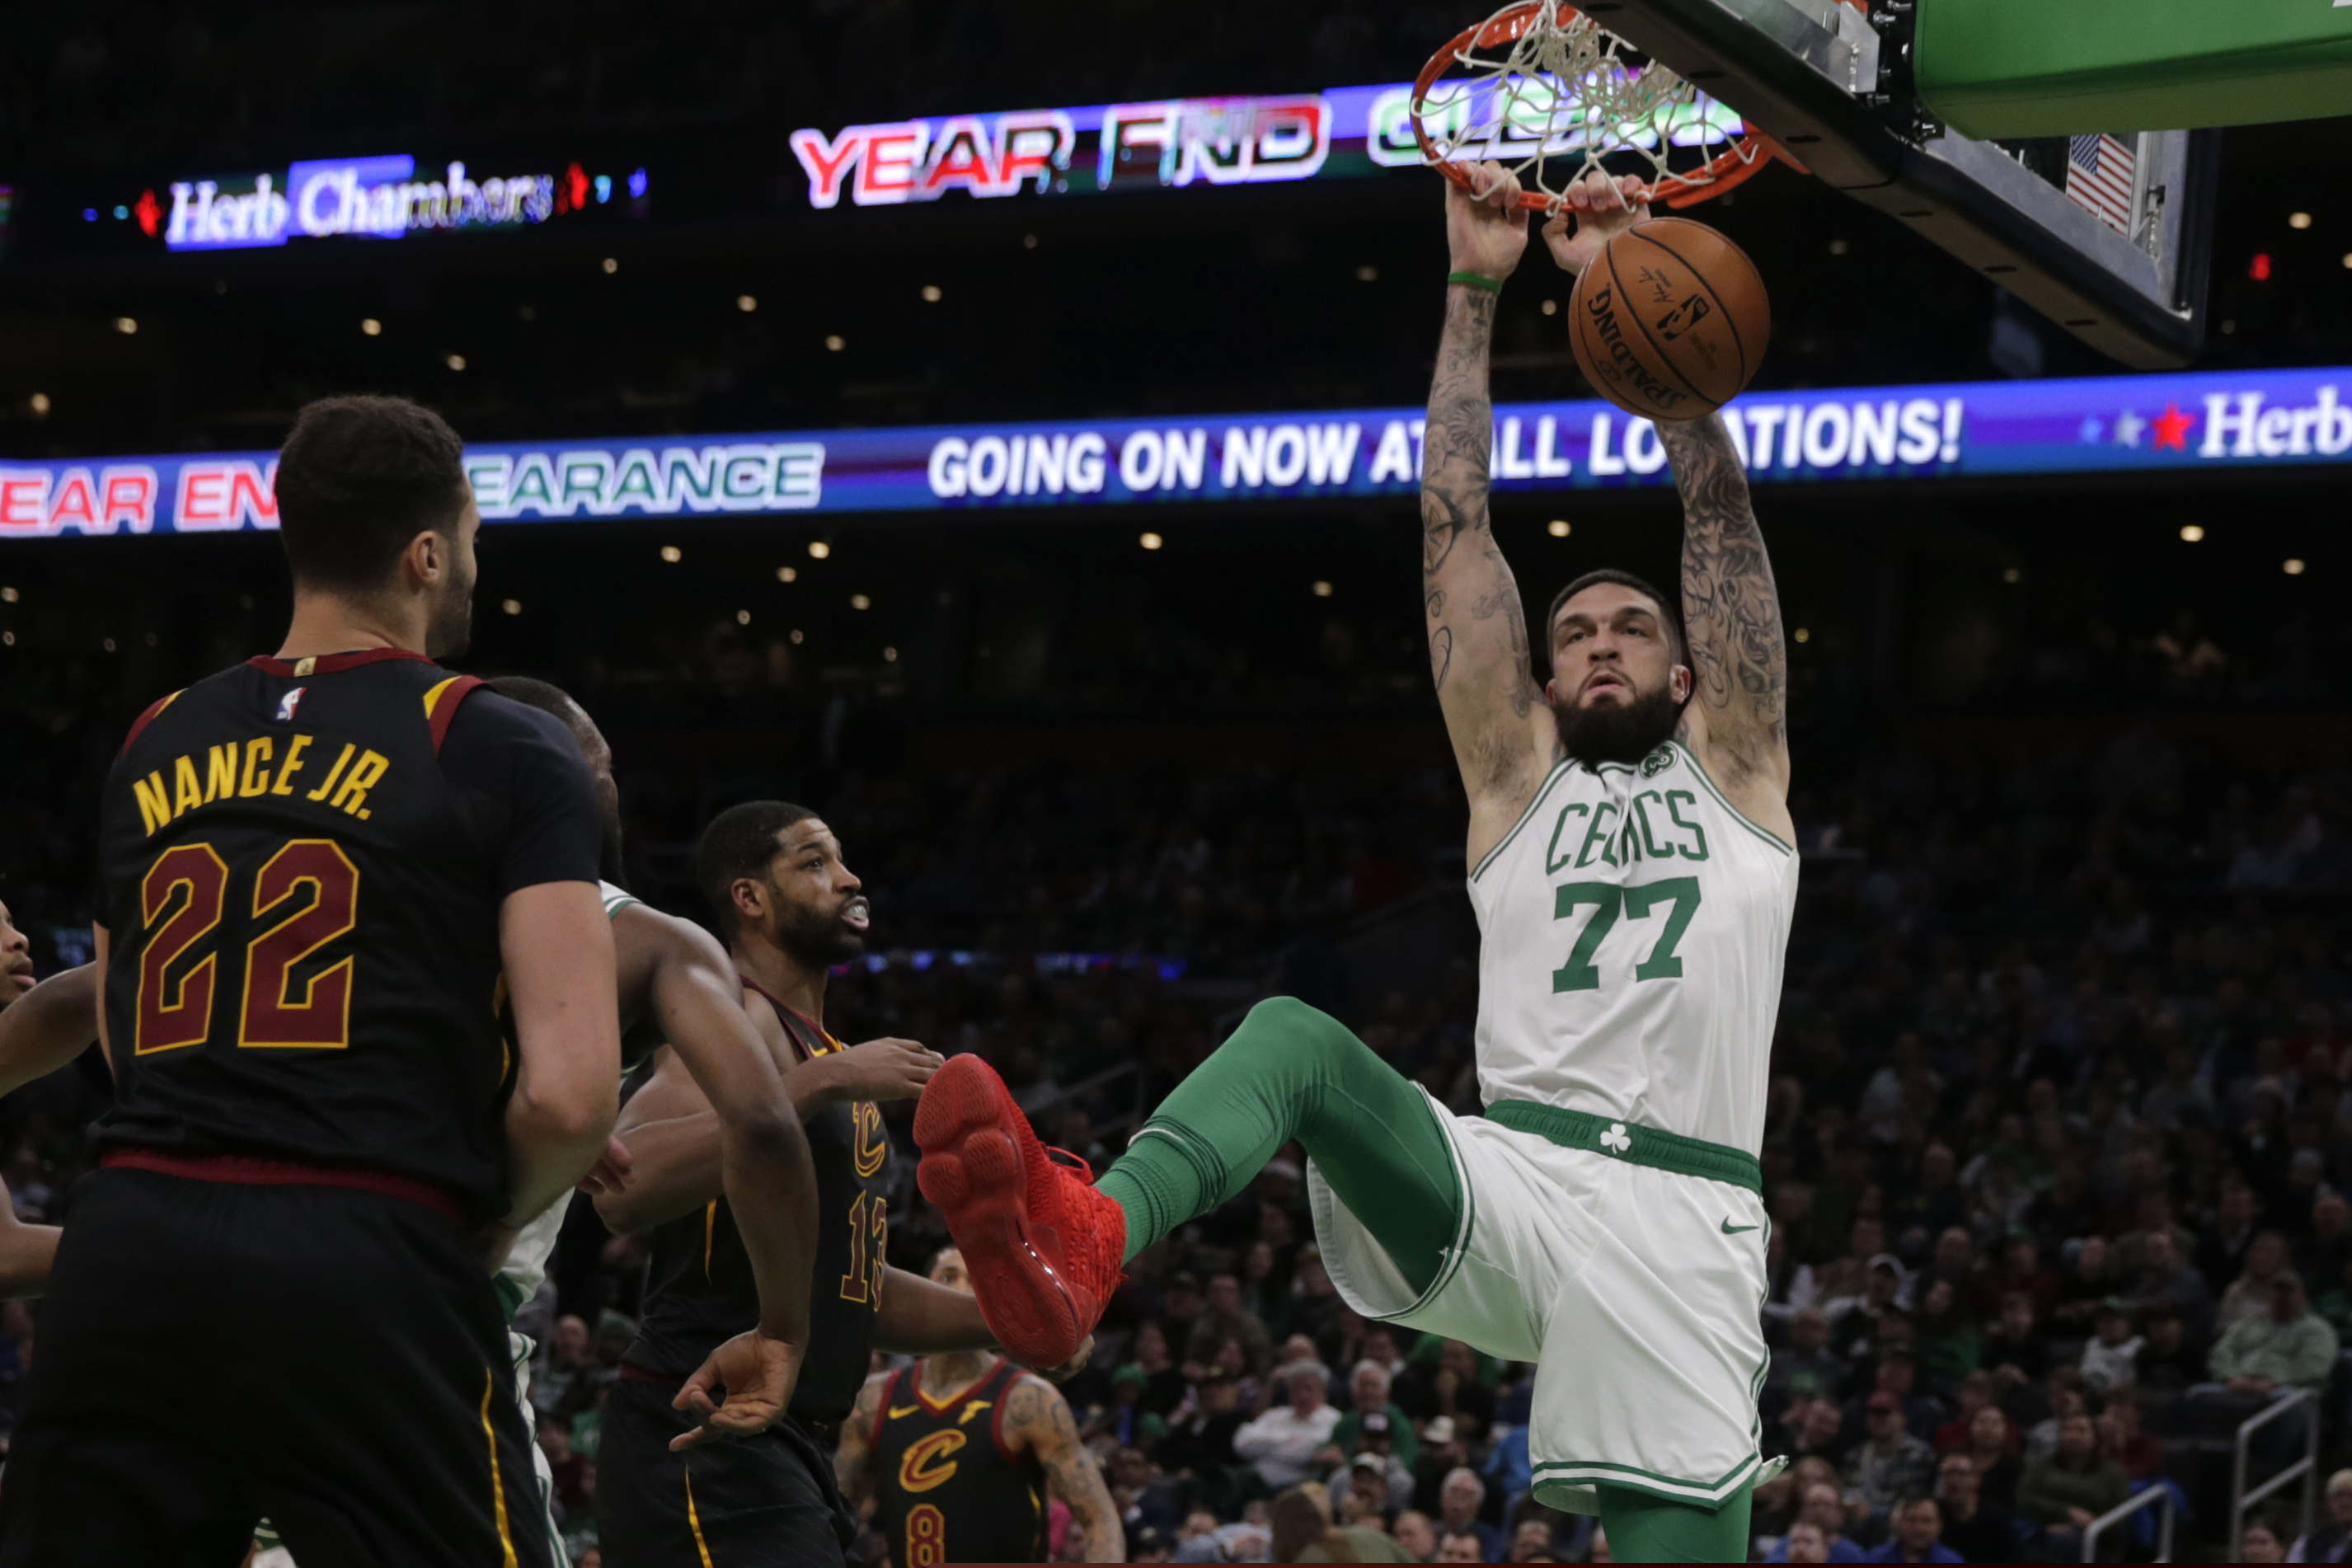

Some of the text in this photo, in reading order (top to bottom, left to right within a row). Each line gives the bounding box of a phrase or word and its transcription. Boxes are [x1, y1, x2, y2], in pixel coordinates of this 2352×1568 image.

[166, 161, 555, 245] Herb Chambers
[790, 110, 1076, 209] YEAR
[1588, 288, 1688, 411] SPALDING
[928, 437, 1106, 498] GOING
[1120, 429, 1207, 492] ON
[1221, 424, 1360, 491] NOW
[1588, 398, 1963, 476] LOTIONS!
[2199, 386, 2352, 460] Herb
[0, 442, 824, 538] EAR EN EARANCE
[133, 735, 390, 837] NANCE JR.
[134, 838, 359, 1056] 22
[1553, 876, 1702, 993] 77
[905, 1503, 946, 1565] 8
